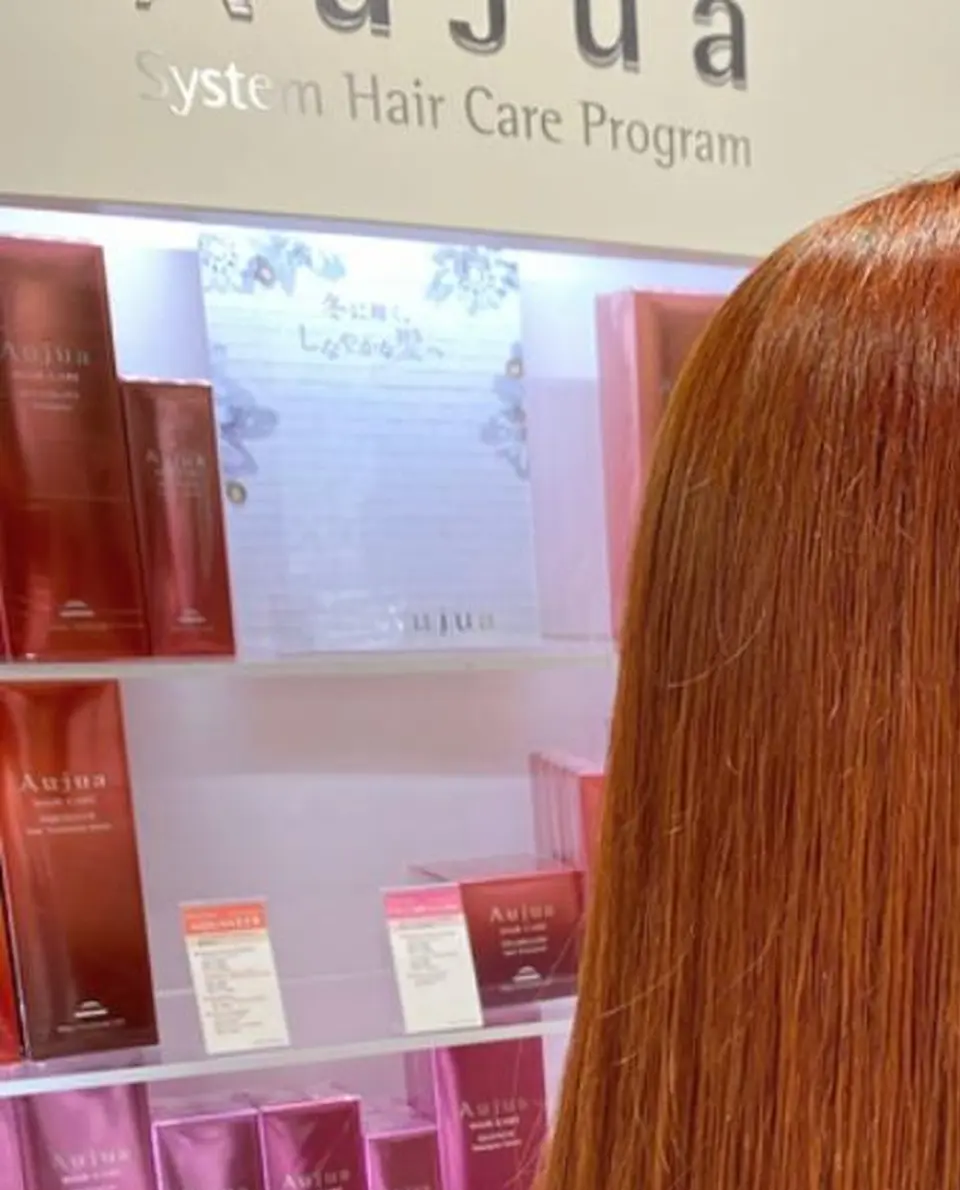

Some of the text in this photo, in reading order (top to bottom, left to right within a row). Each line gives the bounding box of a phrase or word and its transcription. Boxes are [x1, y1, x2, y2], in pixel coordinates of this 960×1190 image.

[136, 0, 748, 90] jua
[135, 49, 752, 170] System Hair Care Program
[17, 771, 107, 794] Aujua
